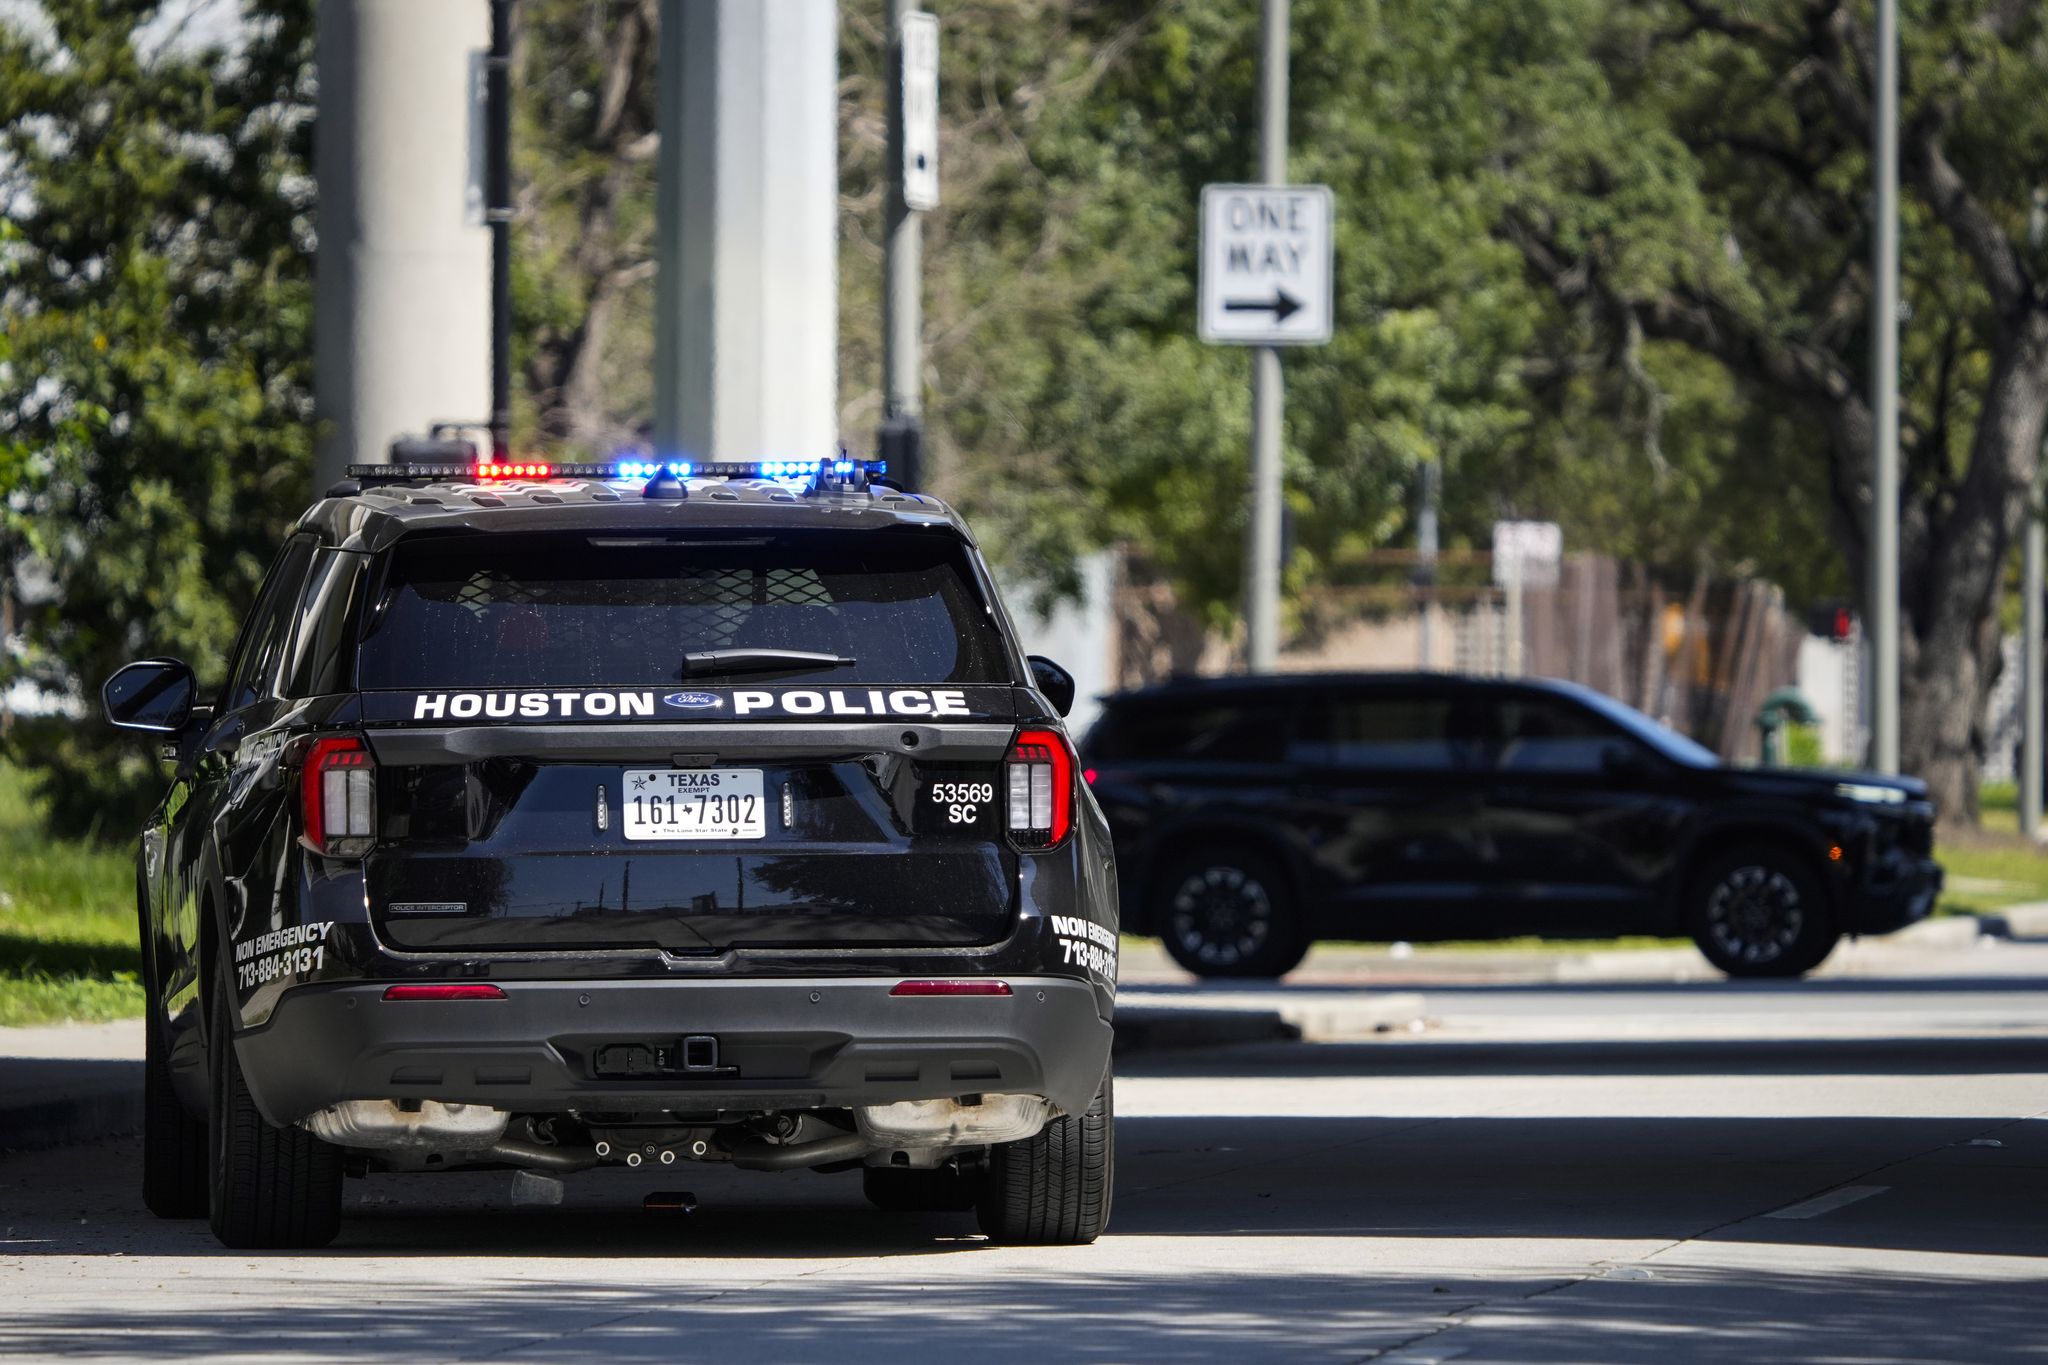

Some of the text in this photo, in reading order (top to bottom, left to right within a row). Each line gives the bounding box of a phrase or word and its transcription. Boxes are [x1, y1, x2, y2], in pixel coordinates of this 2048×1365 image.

[1224, 196, 1309, 233] ONE
[1224, 240, 1308, 273] WAY
[413, 692, 655, 720] HOUSTON
[677, 692, 710, 704] Ford
[732, 690, 971, 717] POLICE
[667, 774, 720, 787] TEXAS
[932, 783, 993, 803] 53569
[948, 804, 977, 824] SC
[1051, 915, 1088, 939] NON
[235, 921, 335, 963] NON EMERGENCY
[238, 945, 325, 990] 713-884-3131
